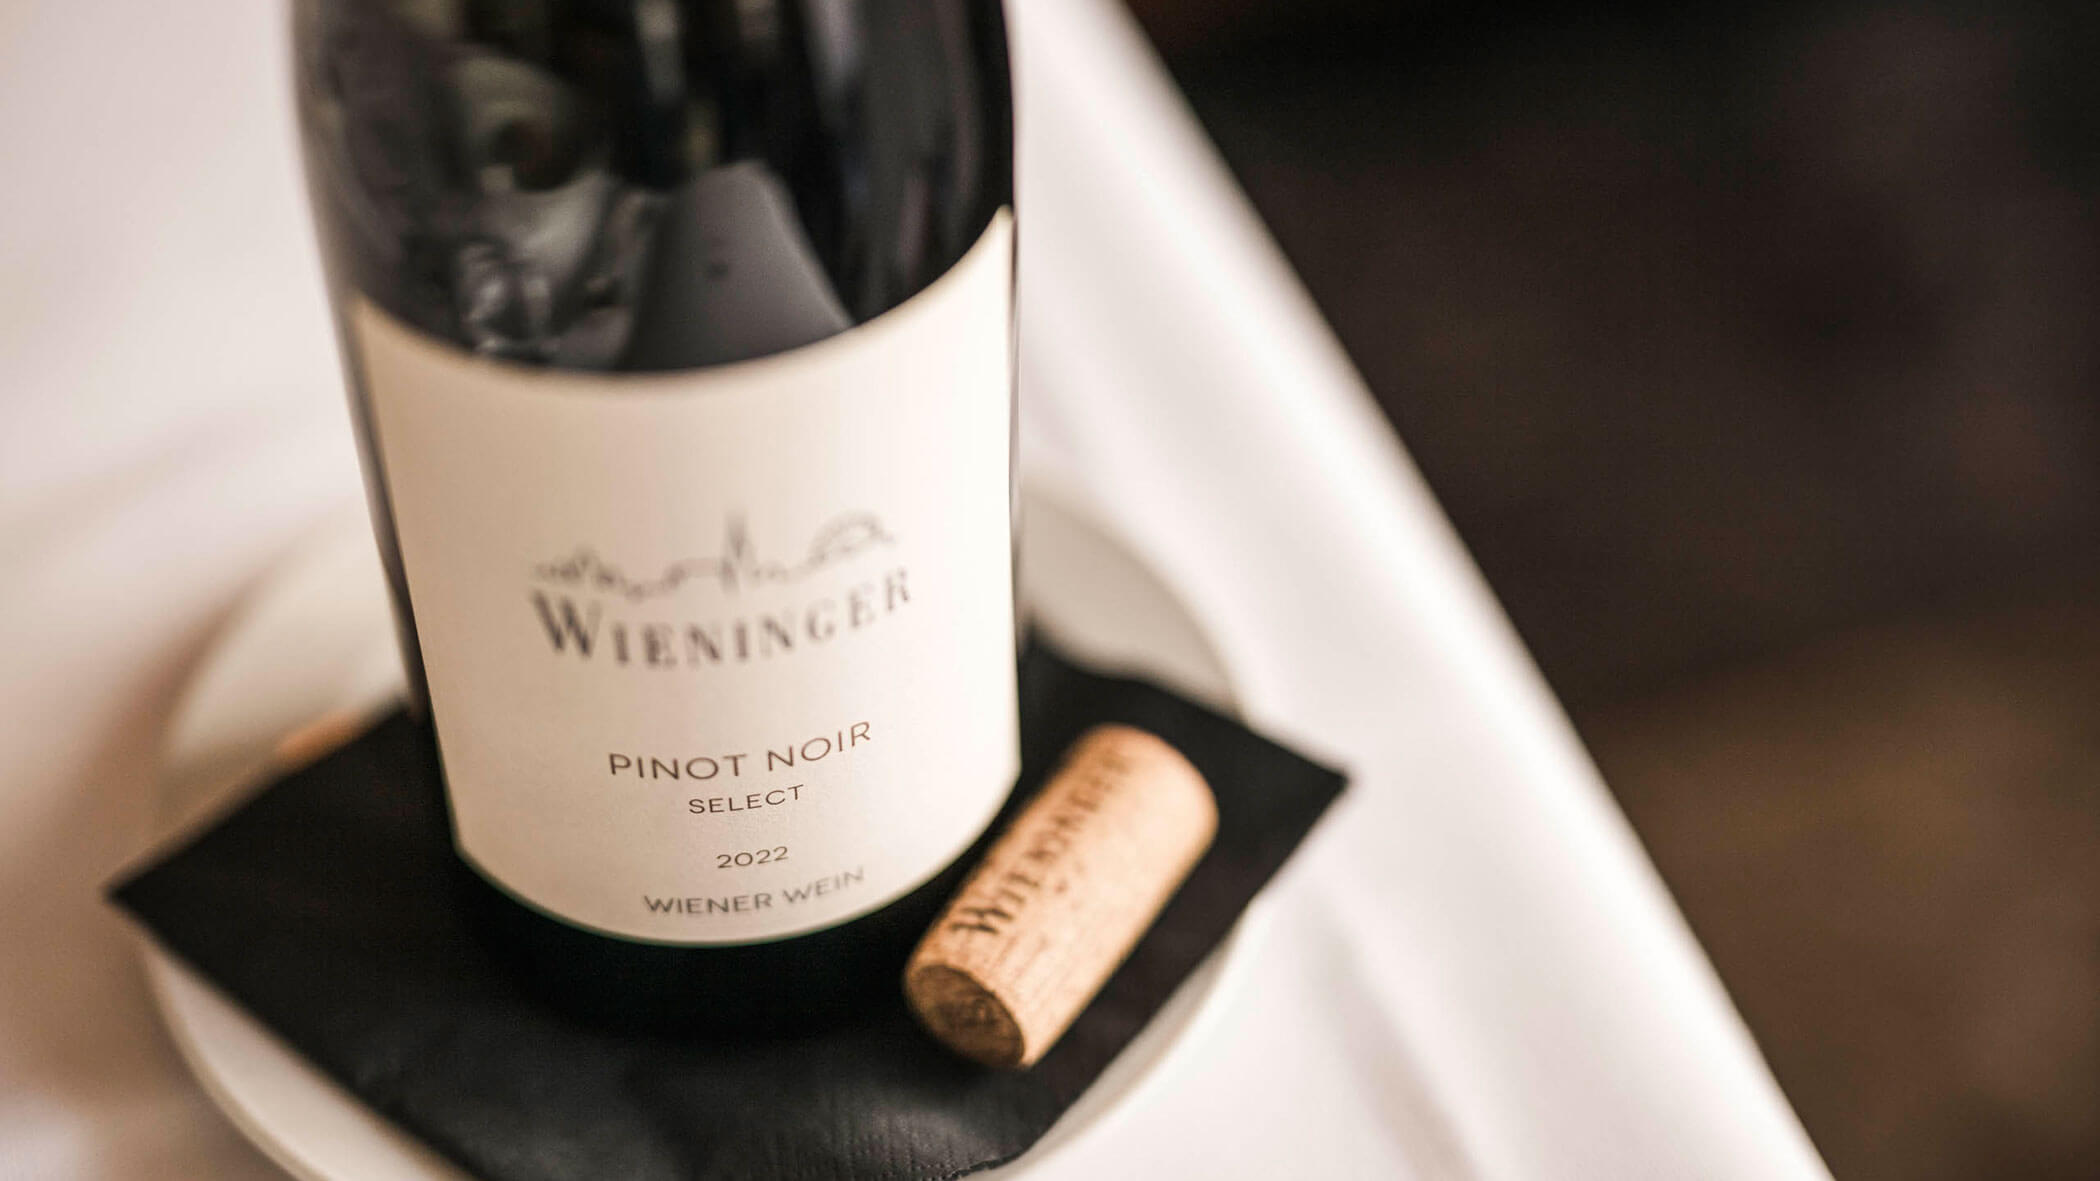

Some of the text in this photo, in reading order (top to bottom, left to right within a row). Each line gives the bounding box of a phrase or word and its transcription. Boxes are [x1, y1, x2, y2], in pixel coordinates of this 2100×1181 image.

[530, 567, 911, 667] WIENINGER
[608, 721, 872, 781] PINOT NOIR
[688, 784, 804, 815] SELECT
[716, 845, 789, 869] 2022
[643, 865, 866, 916] WIENER WEIN
